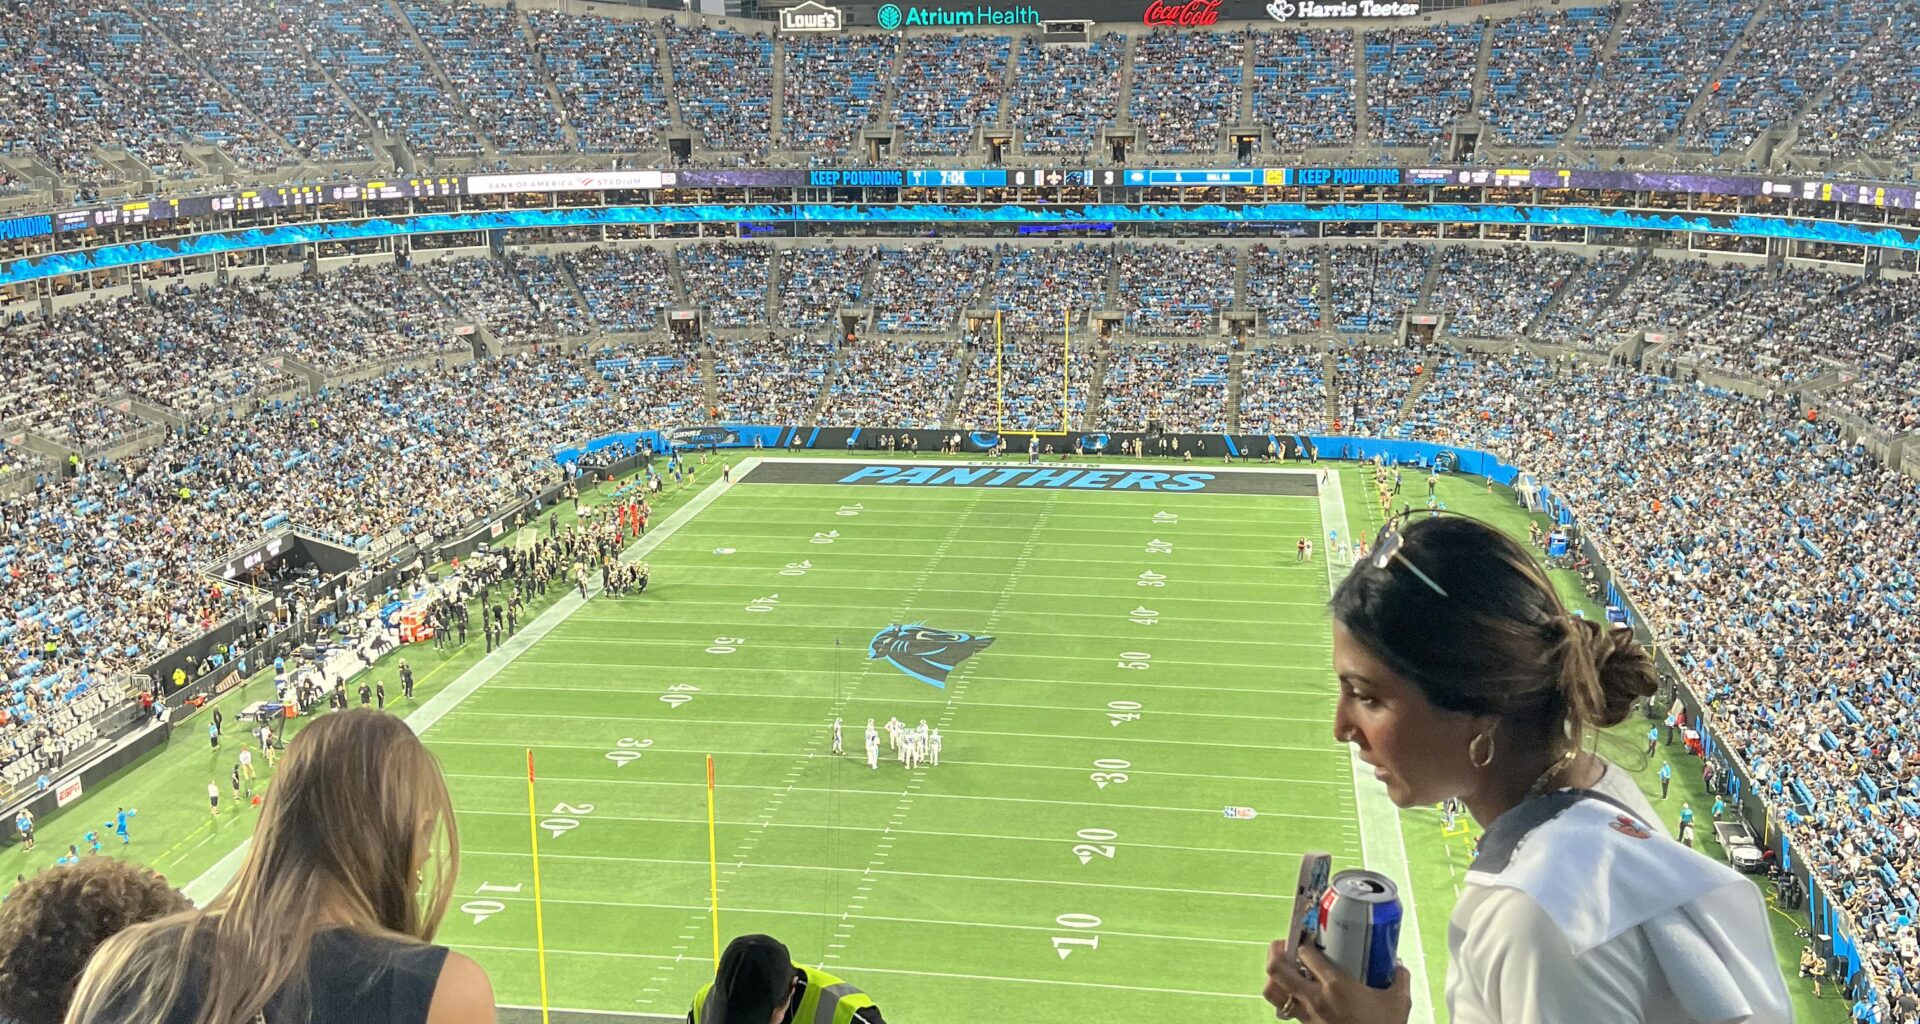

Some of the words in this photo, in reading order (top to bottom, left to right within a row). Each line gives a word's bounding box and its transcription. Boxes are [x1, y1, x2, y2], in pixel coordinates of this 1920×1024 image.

[905, 7, 974, 26] Atrium
[978, 6, 1040, 25] Health
[1143, 0, 1223, 27] Coca-Cola
[1298, 1, 1357, 18] Harris
[1360, 2, 1419, 17] Teeter
[786, 12, 835, 28] LOWE'S
[597, 178, 641, 186] STADIUM
[810, 171, 840, 185] KEEP
[843, 171, 902, 185] POUNDING
[941, 171, 965, 184] 7:04
[1104, 171, 1114, 185] 3
[1299, 169, 1330, 184] KEEP
[1333, 169, 1399, 184] POUNDING
[0, 215, 52, 240] POUNDING
[838, 466, 1216, 491] PANTHERS
[779, 561, 812, 575] 30
[1136, 573, 1167, 587] 30
[1128, 609, 1159, 625] 40
[705, 637, 745, 653] 50
[1117, 652, 1151, 670] 50
[659, 683, 700, 702] 40
[1105, 701, 1143, 722] 40
[605, 738, 653, 761] 30
[1090, 758, 1131, 783] 30
[59, 782, 80, 801] ESPN
[540, 802, 595, 830] 20
[1072, 828, 1118, 859] 20
[460, 881, 522, 914] 10
[1051, 913, 1102, 950] 10
